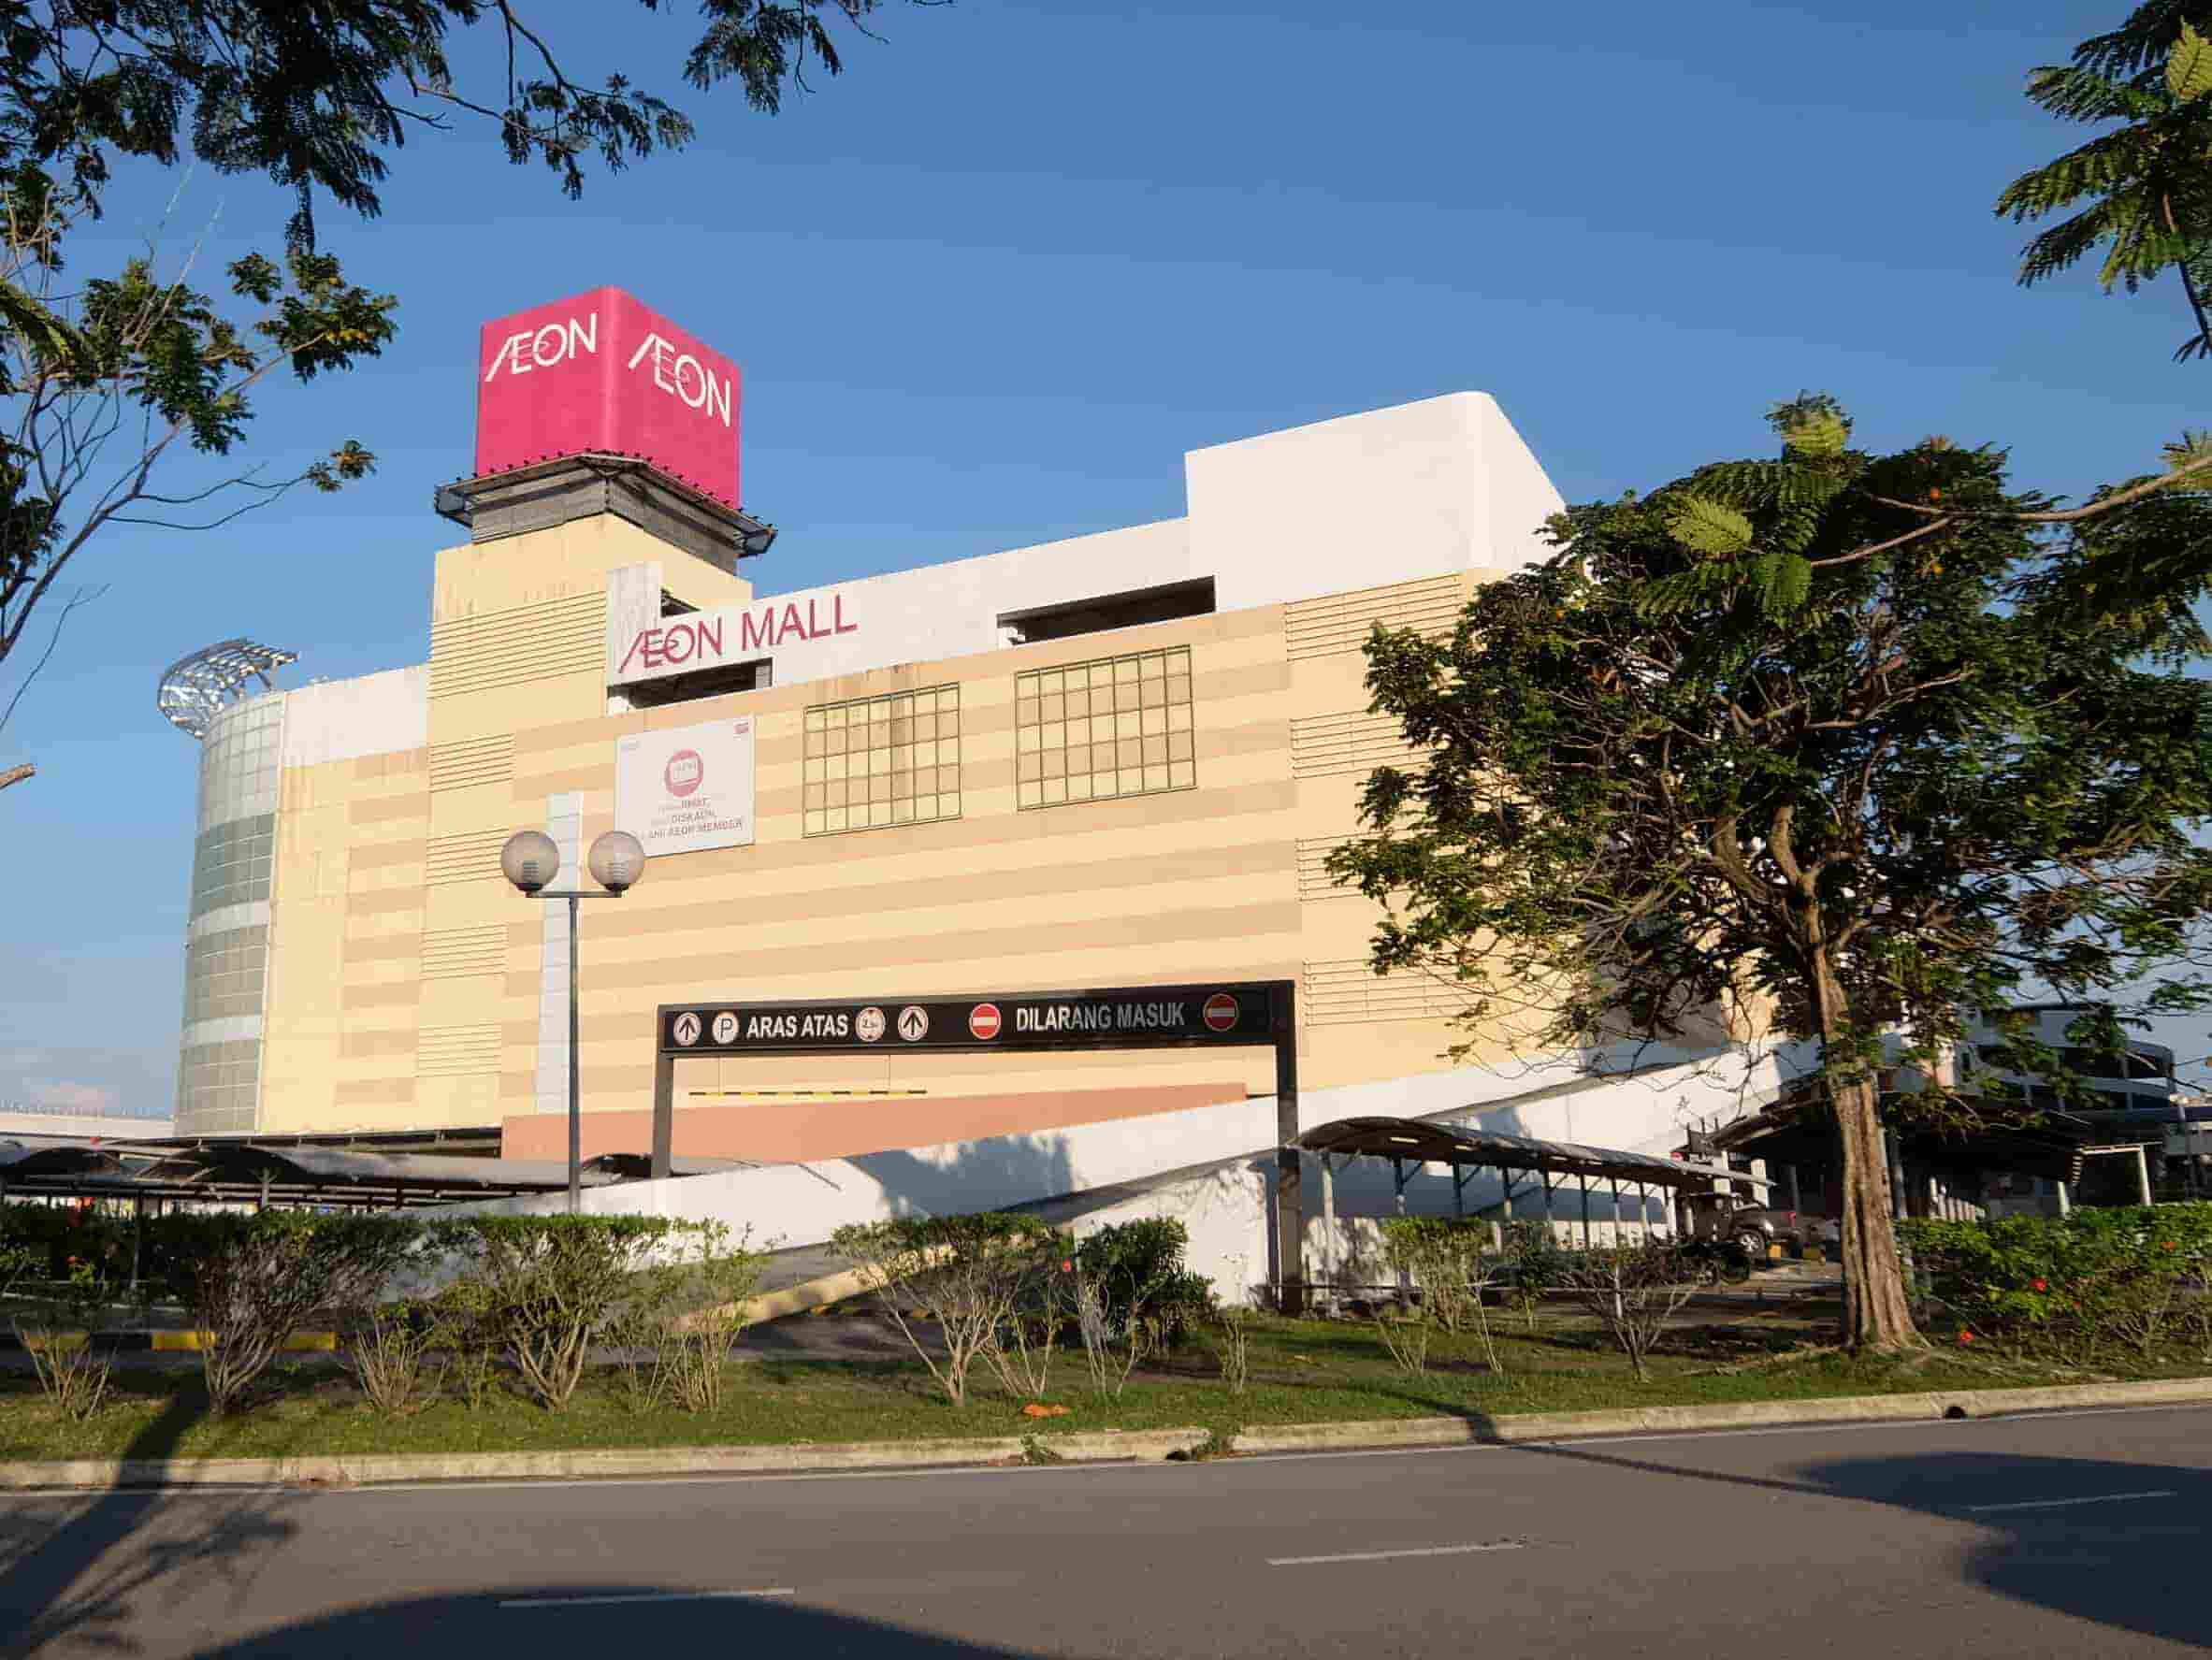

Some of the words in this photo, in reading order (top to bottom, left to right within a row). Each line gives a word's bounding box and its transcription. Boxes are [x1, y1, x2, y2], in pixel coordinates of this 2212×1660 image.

[742, 594, 859, 652] MALL
[720, 1017, 734, 1041] P
[746, 1016, 797, 1039] ARAS
[801, 1014, 848, 1037] ATAS
[1016, 1005, 1112, 1032] DILARANG
[1118, 1002, 1186, 1028] MASUK
